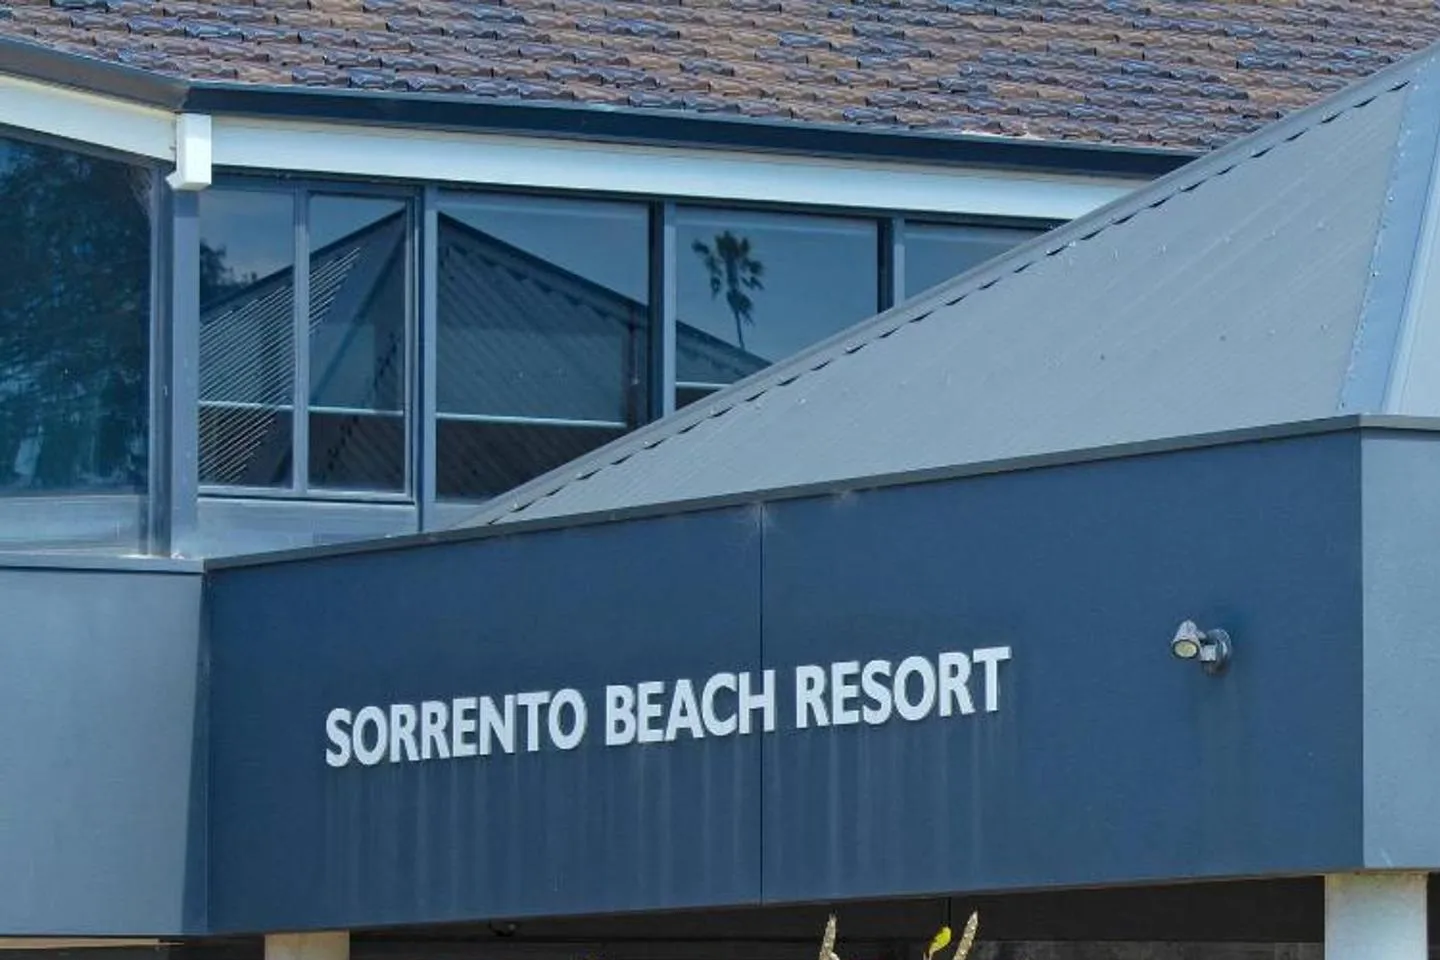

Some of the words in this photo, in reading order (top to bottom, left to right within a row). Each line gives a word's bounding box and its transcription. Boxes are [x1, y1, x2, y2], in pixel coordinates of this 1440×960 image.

[325, 688, 588, 768] SORRENTO
[605, 669, 776, 746] BEACH
[796, 646, 1011, 728] RESORT
